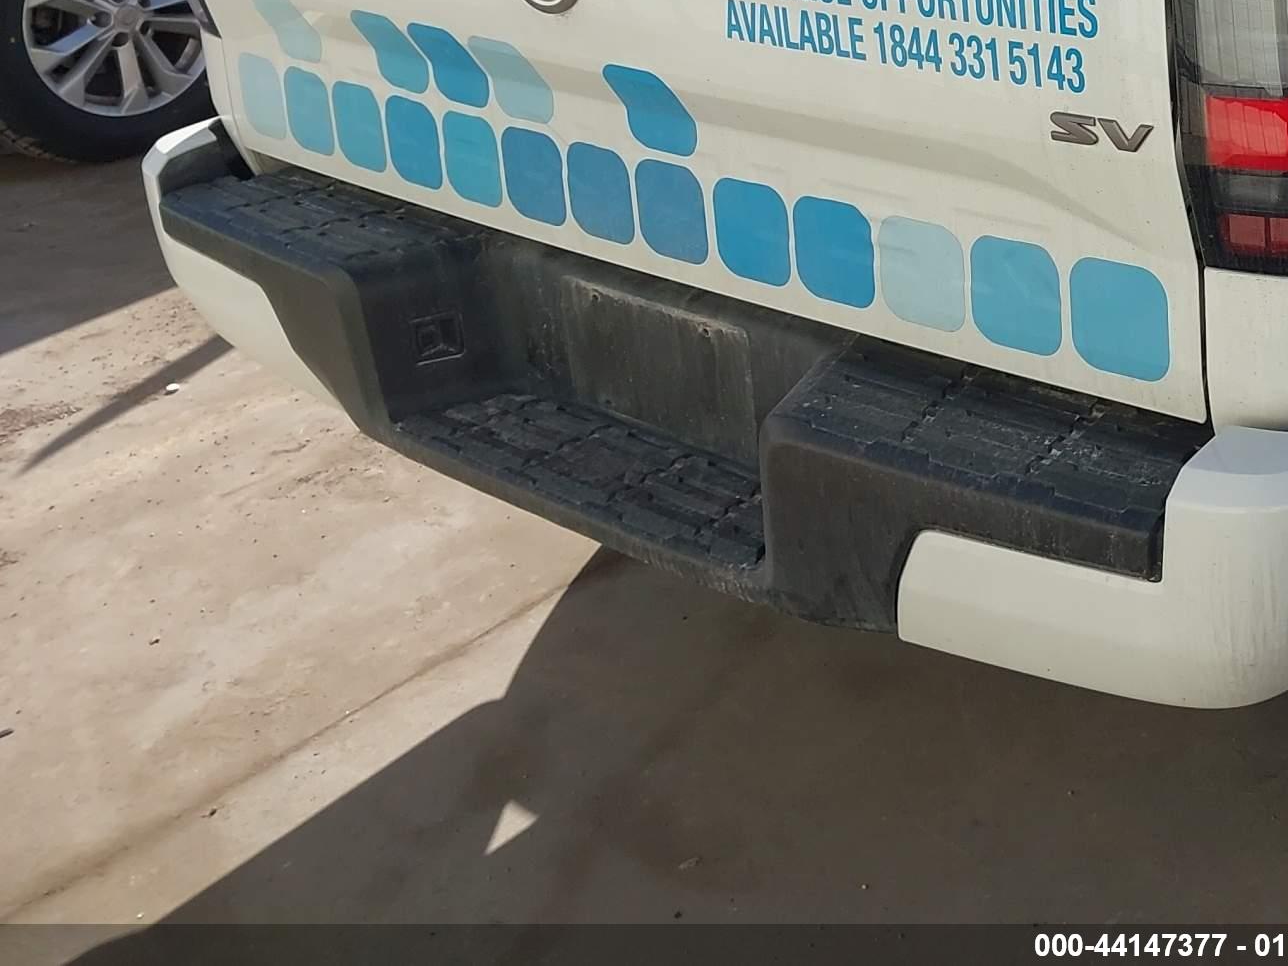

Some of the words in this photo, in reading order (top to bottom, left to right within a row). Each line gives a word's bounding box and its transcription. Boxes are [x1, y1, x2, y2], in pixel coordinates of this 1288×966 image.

[872, 20, 942, 73] 1844
[948, 32, 1000, 82] 331
[1008, 40, 1086, 94] 5143
[1050, 111, 1154, 153] SV
